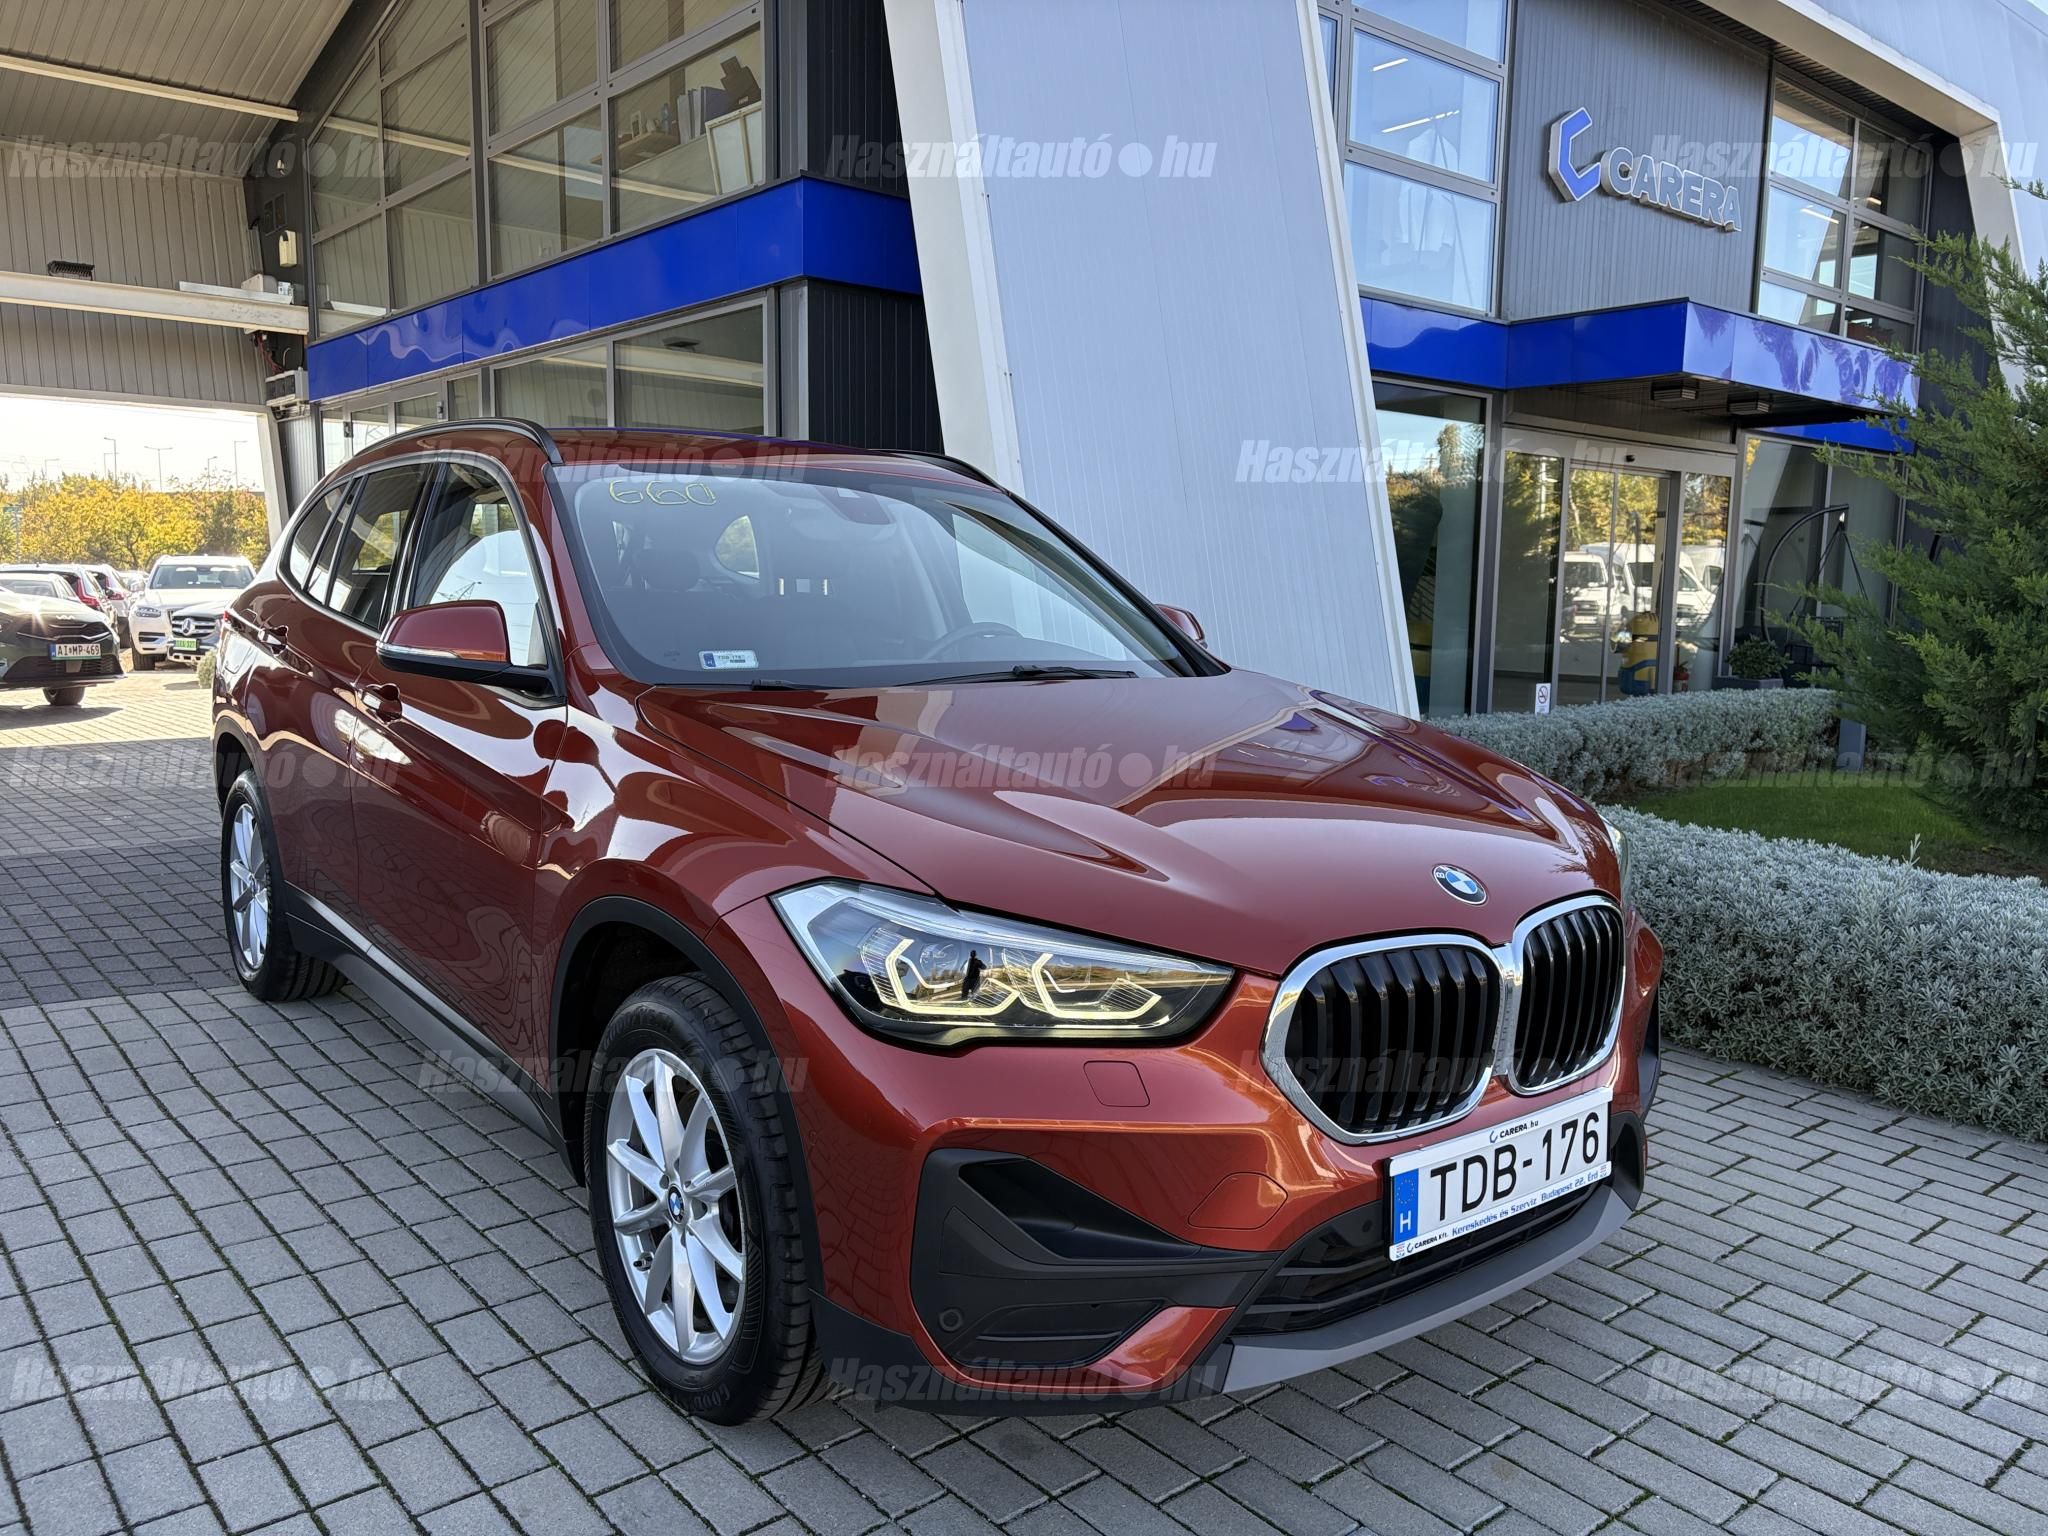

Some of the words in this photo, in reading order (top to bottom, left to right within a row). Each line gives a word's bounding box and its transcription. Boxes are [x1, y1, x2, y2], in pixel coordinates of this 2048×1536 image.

[1603, 147, 1741, 231] CARERA
[1500, 1123, 1527, 1138] CARERA
[1430, 1112, 1599, 1221] TDB-176
[1400, 1210, 1411, 1233] H
[1414, 1235, 1438, 1249] CARERA
[1452, 1212, 1498, 1236] Kereskedés
[1499, 1208, 1509, 1218] és
[1510, 1198, 1537, 1213] Szerviz
[1541, 1182, 1573, 1201] Budapest
